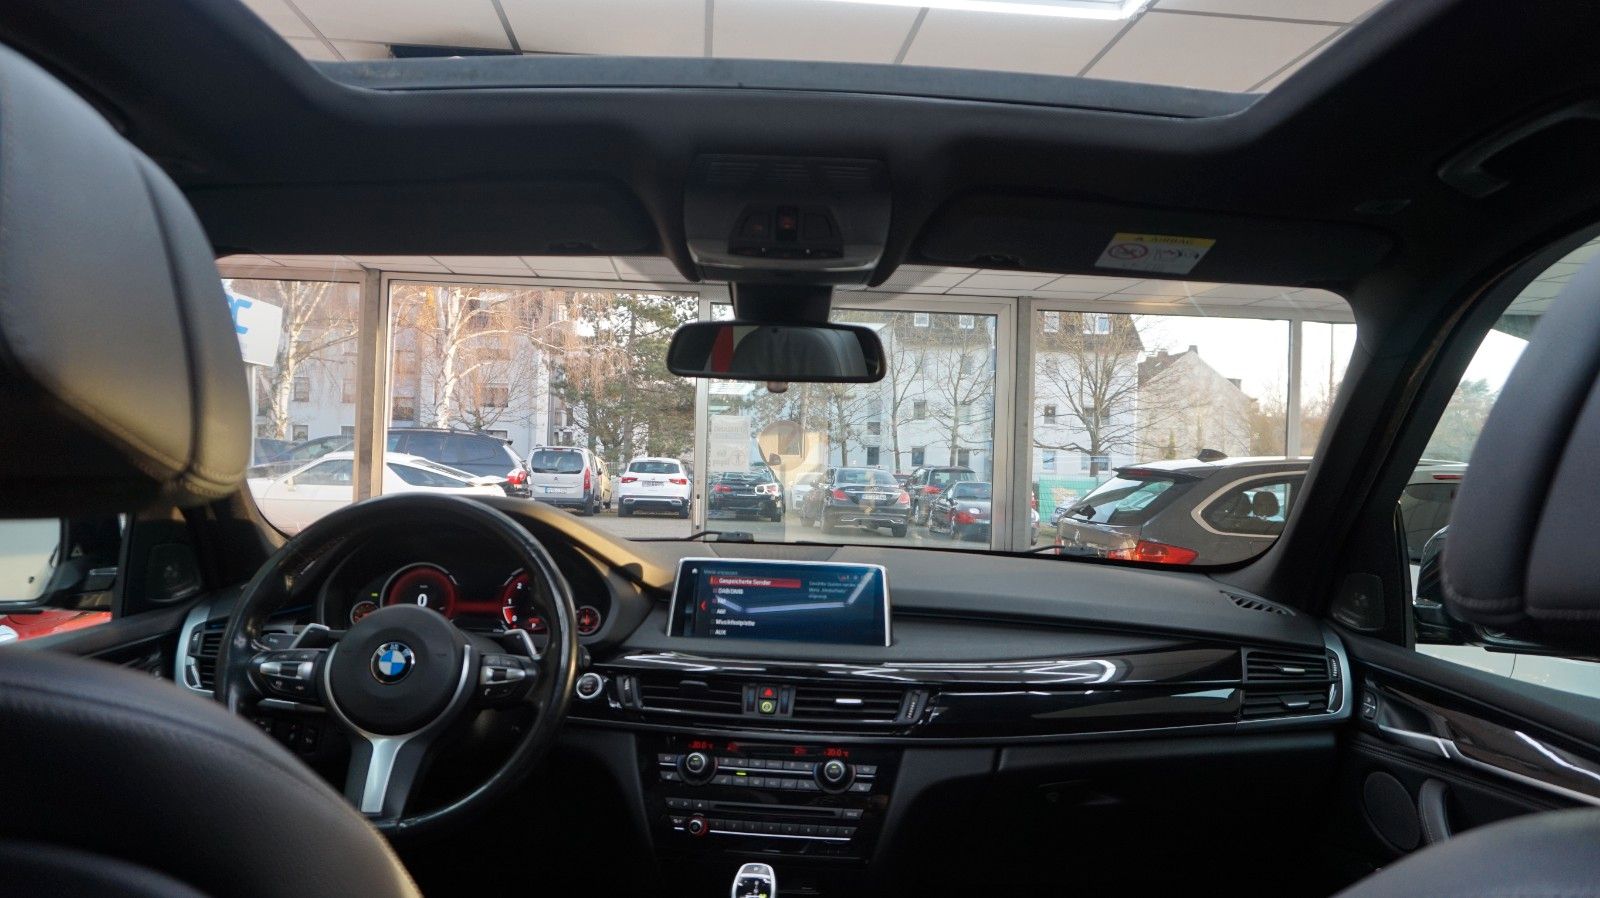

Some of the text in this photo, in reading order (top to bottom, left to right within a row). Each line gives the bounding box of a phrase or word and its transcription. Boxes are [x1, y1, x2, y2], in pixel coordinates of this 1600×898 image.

[719, 577, 752, 586] Gespeicherte
[417, 593, 428, 607] 0
[715, 619, 756, 627] Musikfestplatte
[377, 642, 412, 657] BMW
